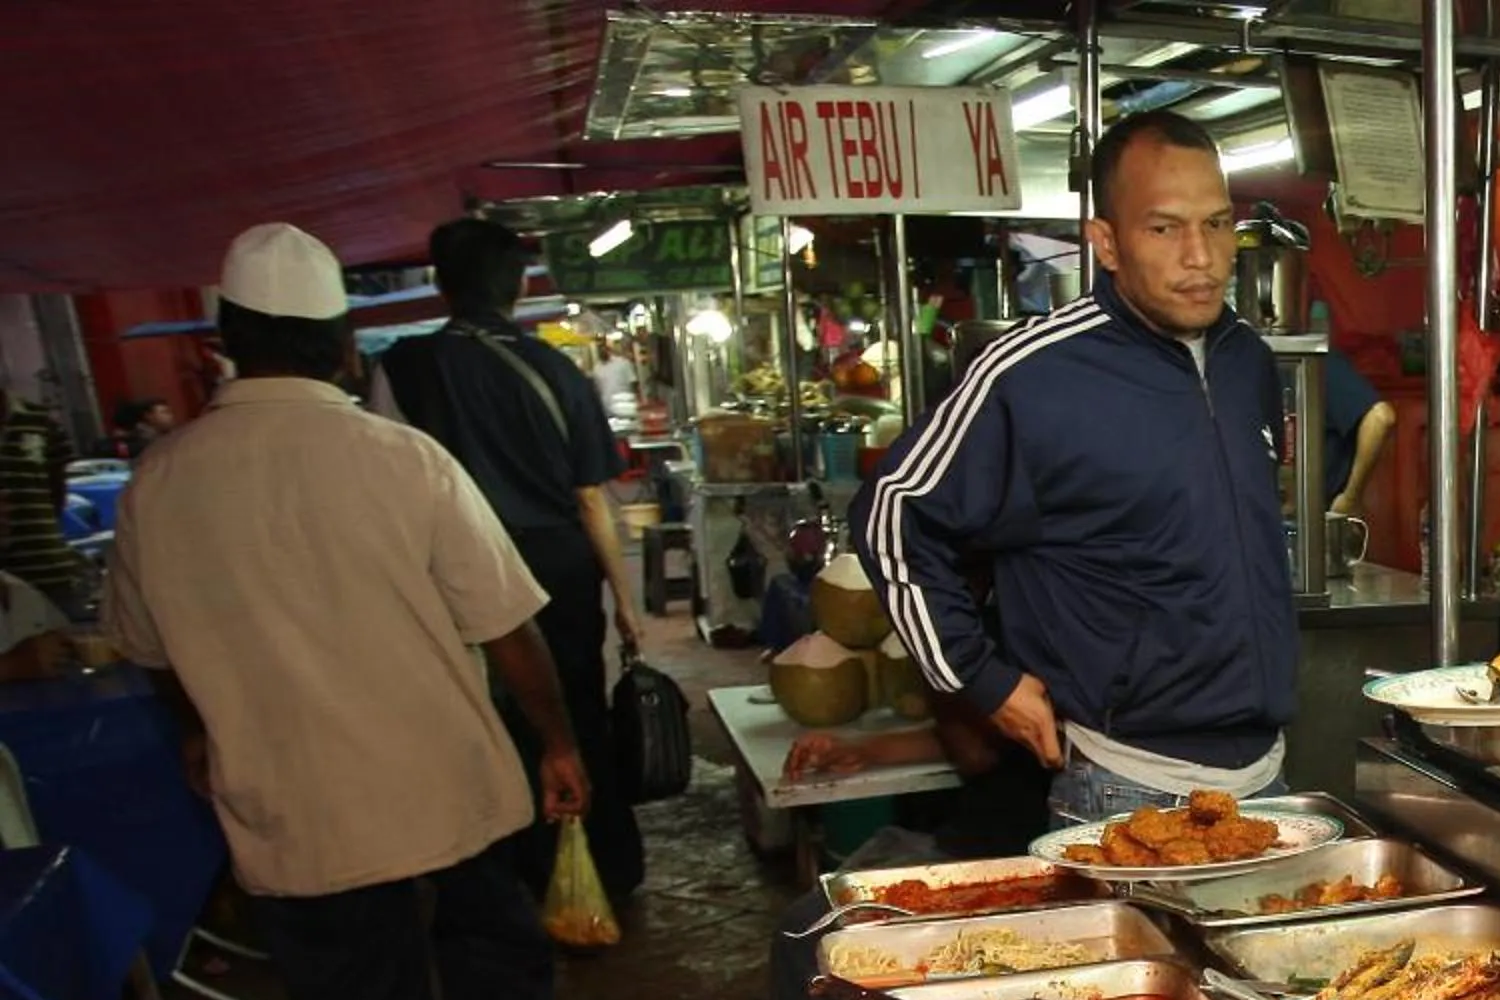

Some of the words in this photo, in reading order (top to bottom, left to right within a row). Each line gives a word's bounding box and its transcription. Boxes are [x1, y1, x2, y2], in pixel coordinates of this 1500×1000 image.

[760, 101, 817, 200] AIR
[816, 101, 903, 199] TEBU
[962, 101, 1009, 197] YA
[560, 229, 645, 268] SP
